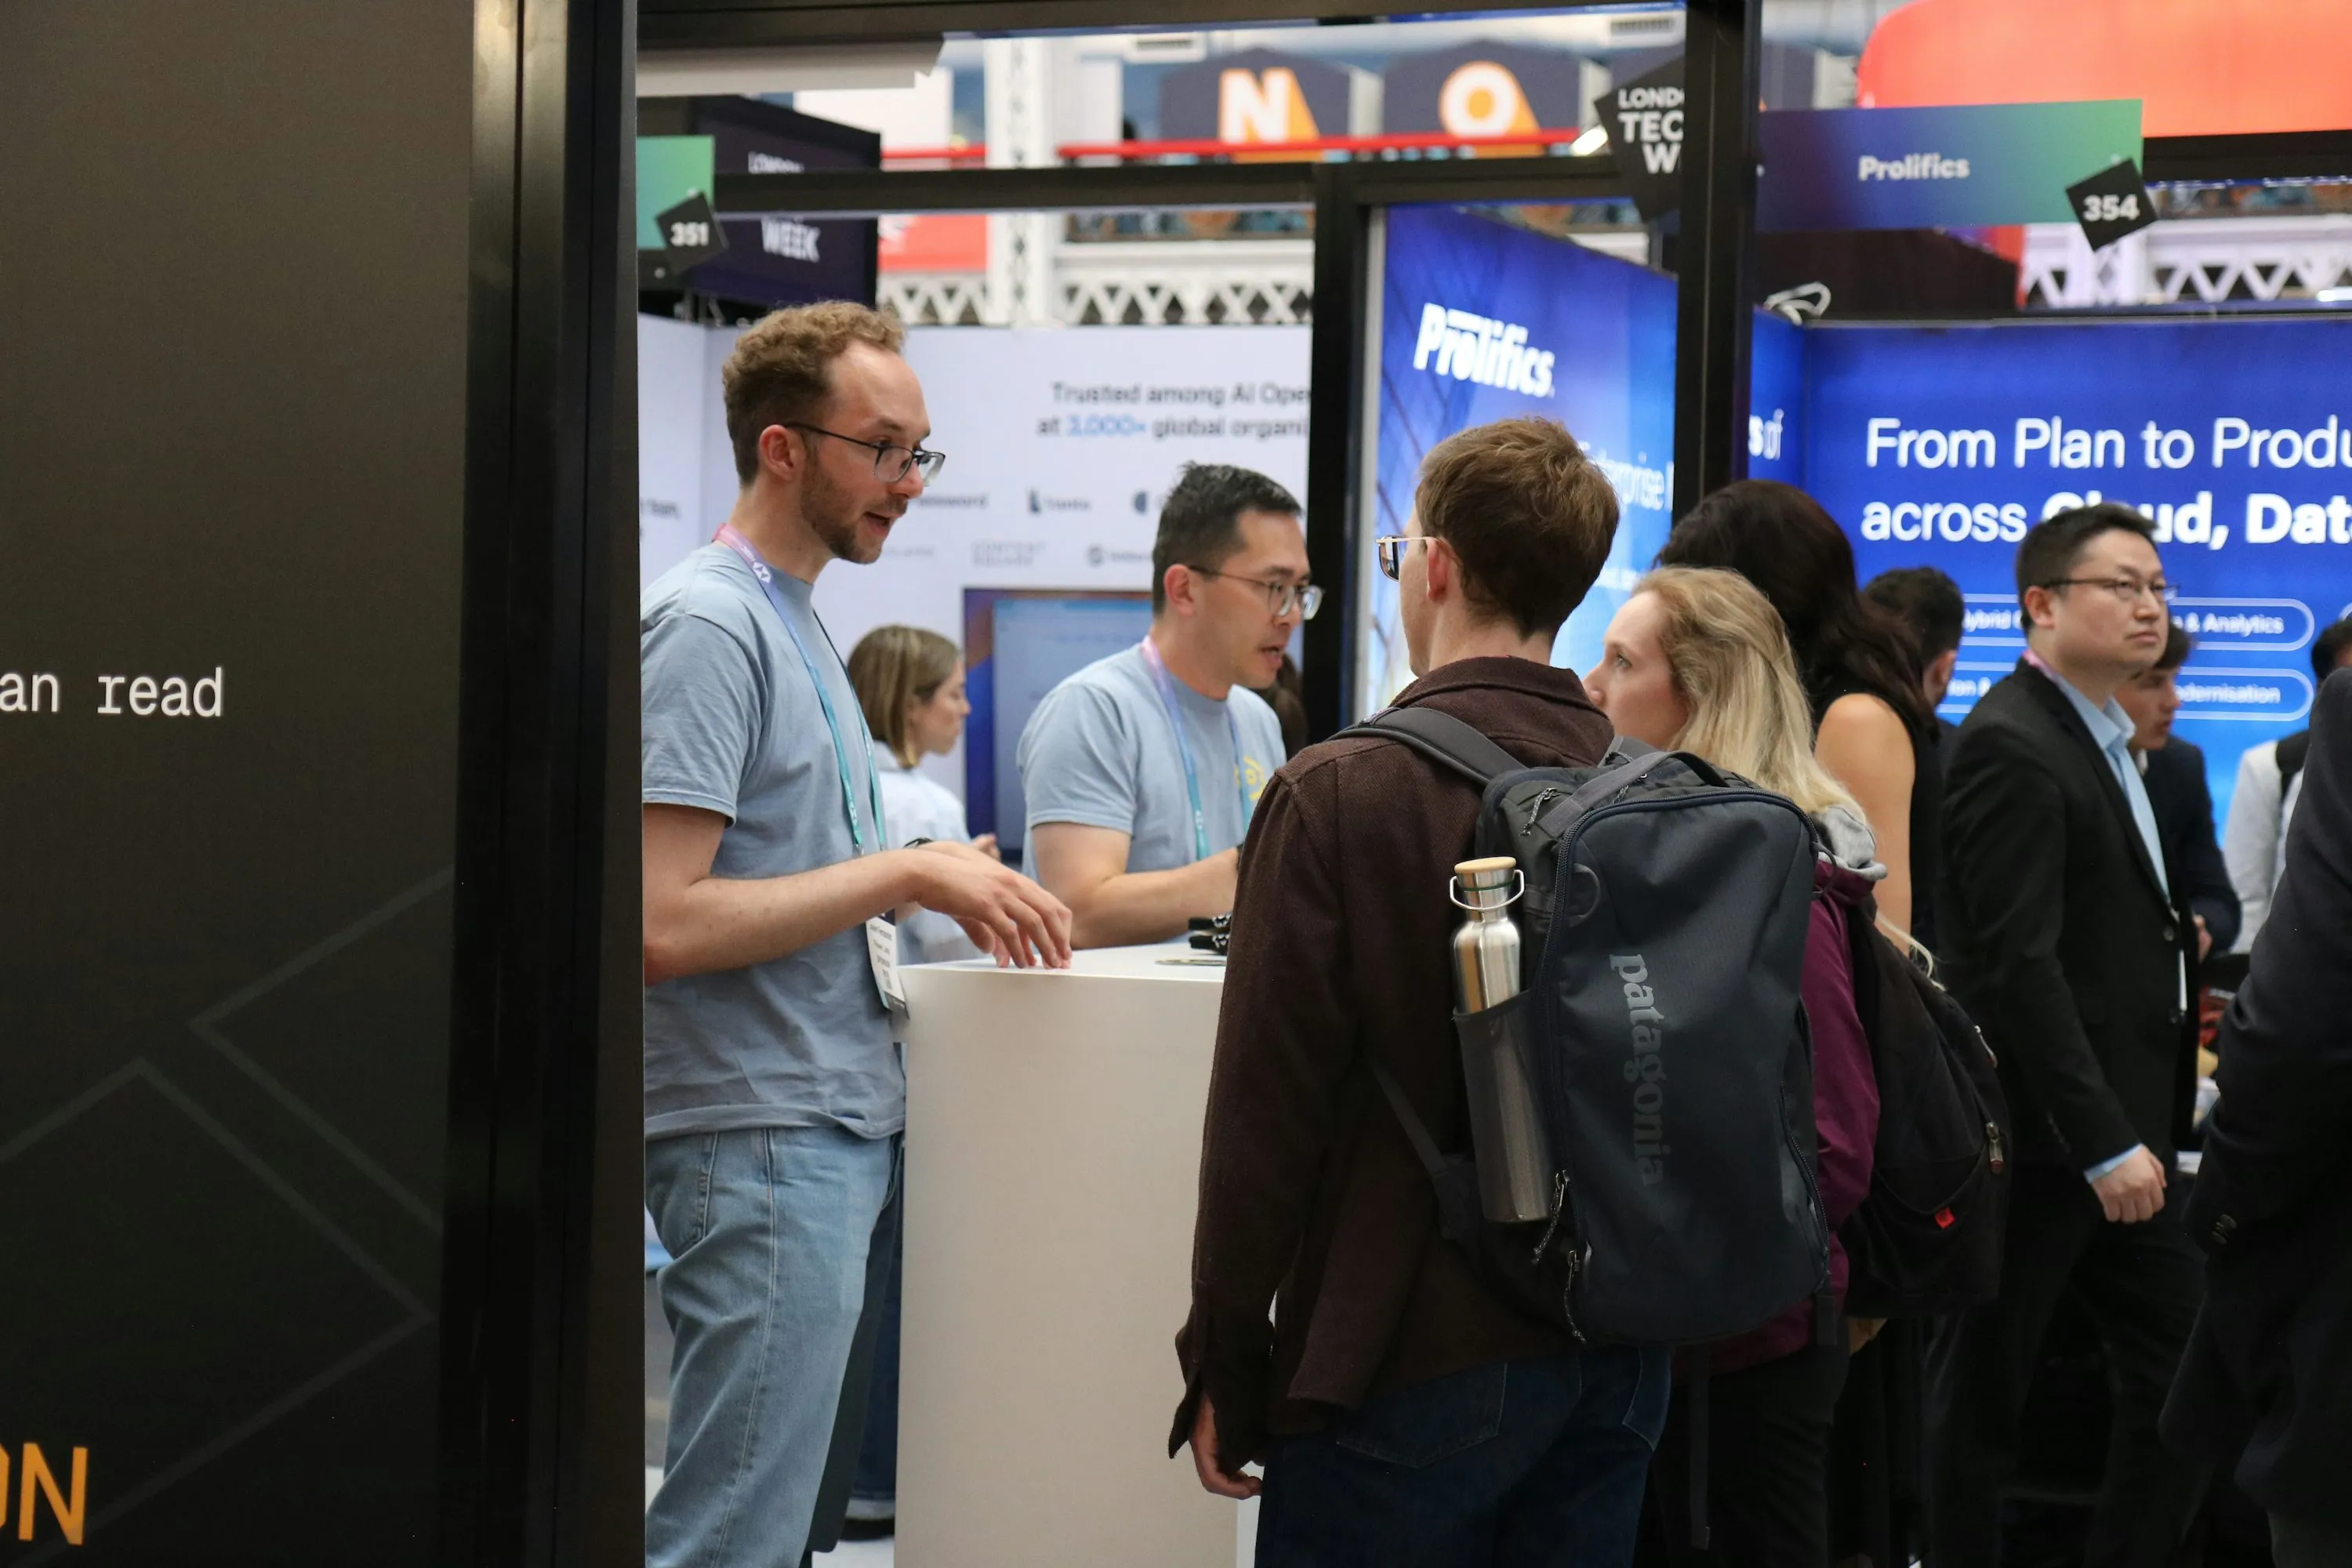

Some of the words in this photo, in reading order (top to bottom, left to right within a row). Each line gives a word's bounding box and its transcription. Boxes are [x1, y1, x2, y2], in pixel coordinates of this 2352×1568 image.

[1617, 86, 1685, 110] LOND
[1858, 153, 1970, 182] Prolifics
[2083, 194, 2140, 221] 354
[671, 222, 710, 247] 351
[761, 216, 821, 263] WEEK
[1053, 381, 1142, 405] Trusted
[1147, 385, 1226, 408] among
[1152, 417, 1226, 441] global
[1867, 417, 1997, 469] From
[2014, 416, 2126, 469] Plan
[2142, 421, 2195, 470] to
[1860, 502, 2028, 543] across
[2245, 492, 2352, 545] Dat
[2203, 612, 2285, 637] Analytics
[97, 666, 223, 718] read
[1609, 953, 1671, 1186] patagonia
